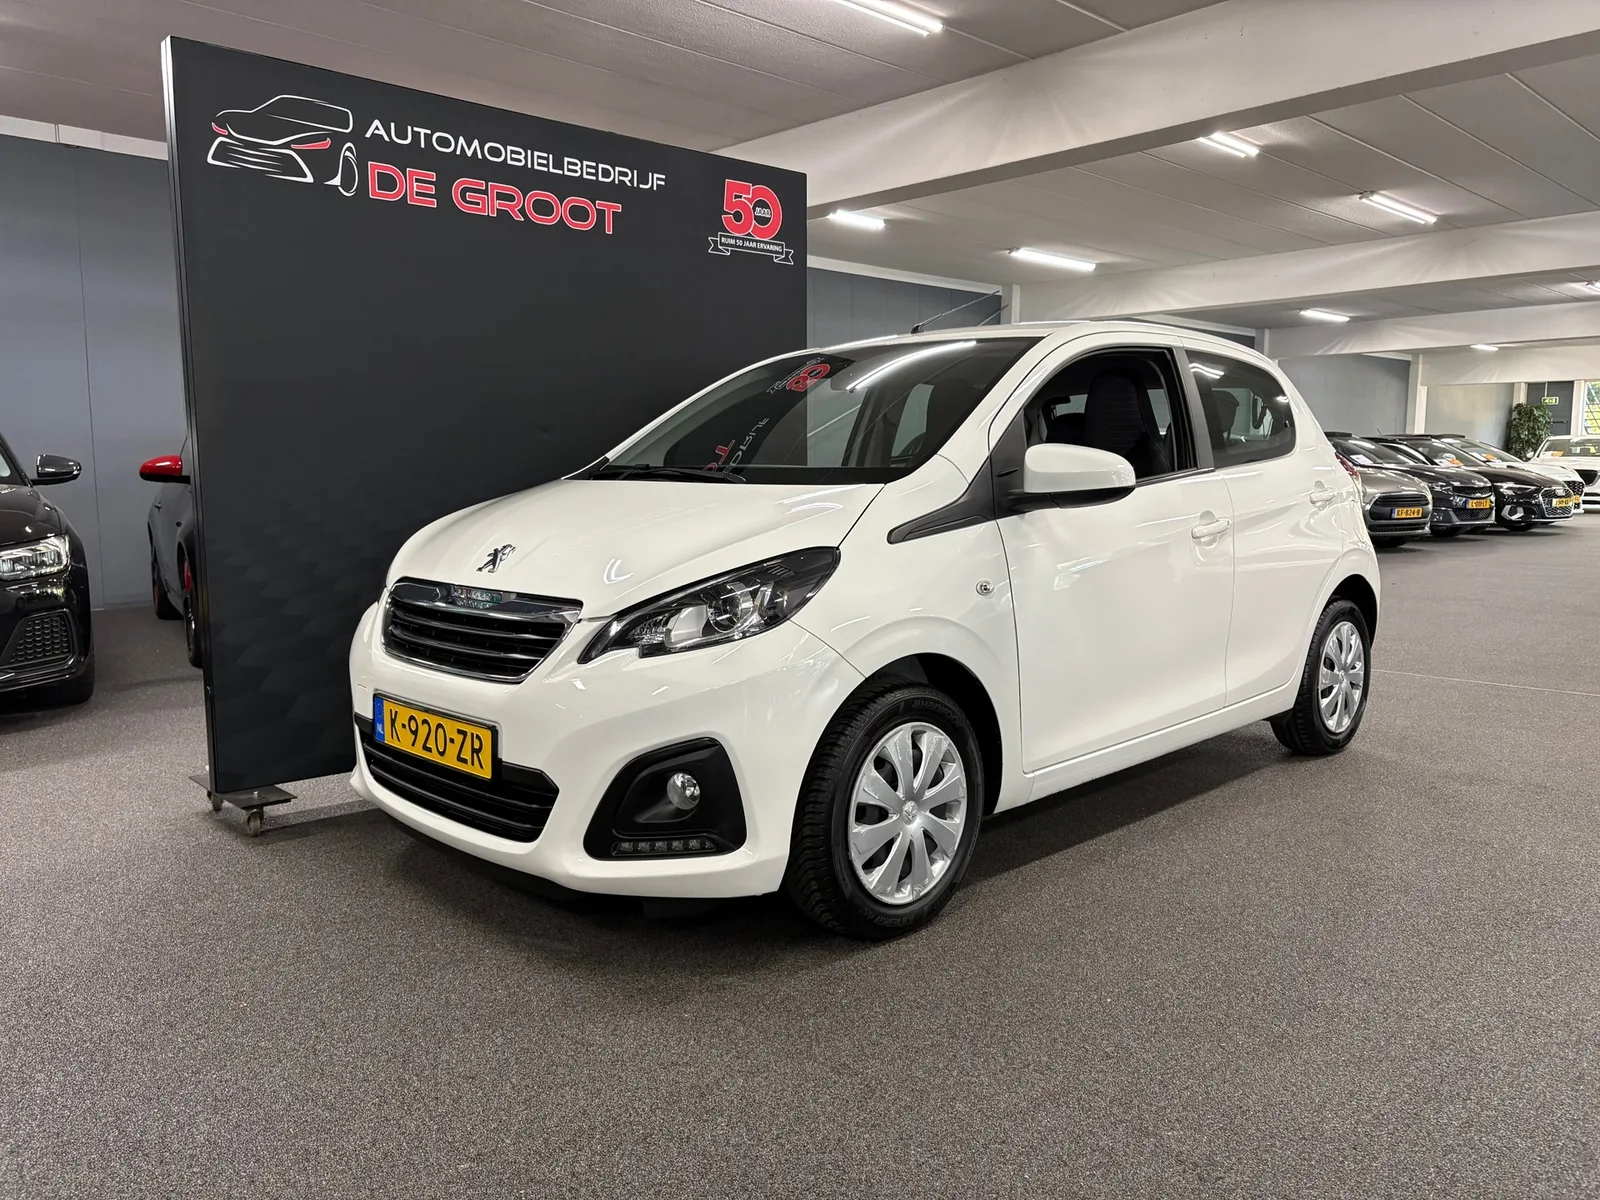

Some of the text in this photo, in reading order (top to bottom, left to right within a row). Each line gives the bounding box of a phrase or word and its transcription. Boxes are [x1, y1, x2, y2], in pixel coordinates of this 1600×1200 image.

[364, 118, 666, 191] AUTOMOBIELBEDRIJF
[367, 161, 622, 235] DE GROOT
[721, 178, 783, 241] 50
[754, 207, 771, 218] JAAR
[721, 237, 735, 245] RUIM
[757, 243, 782, 252] ERVARING
[376, 722, 384, 735] NL
[389, 708, 485, 770] K-920-ZR
